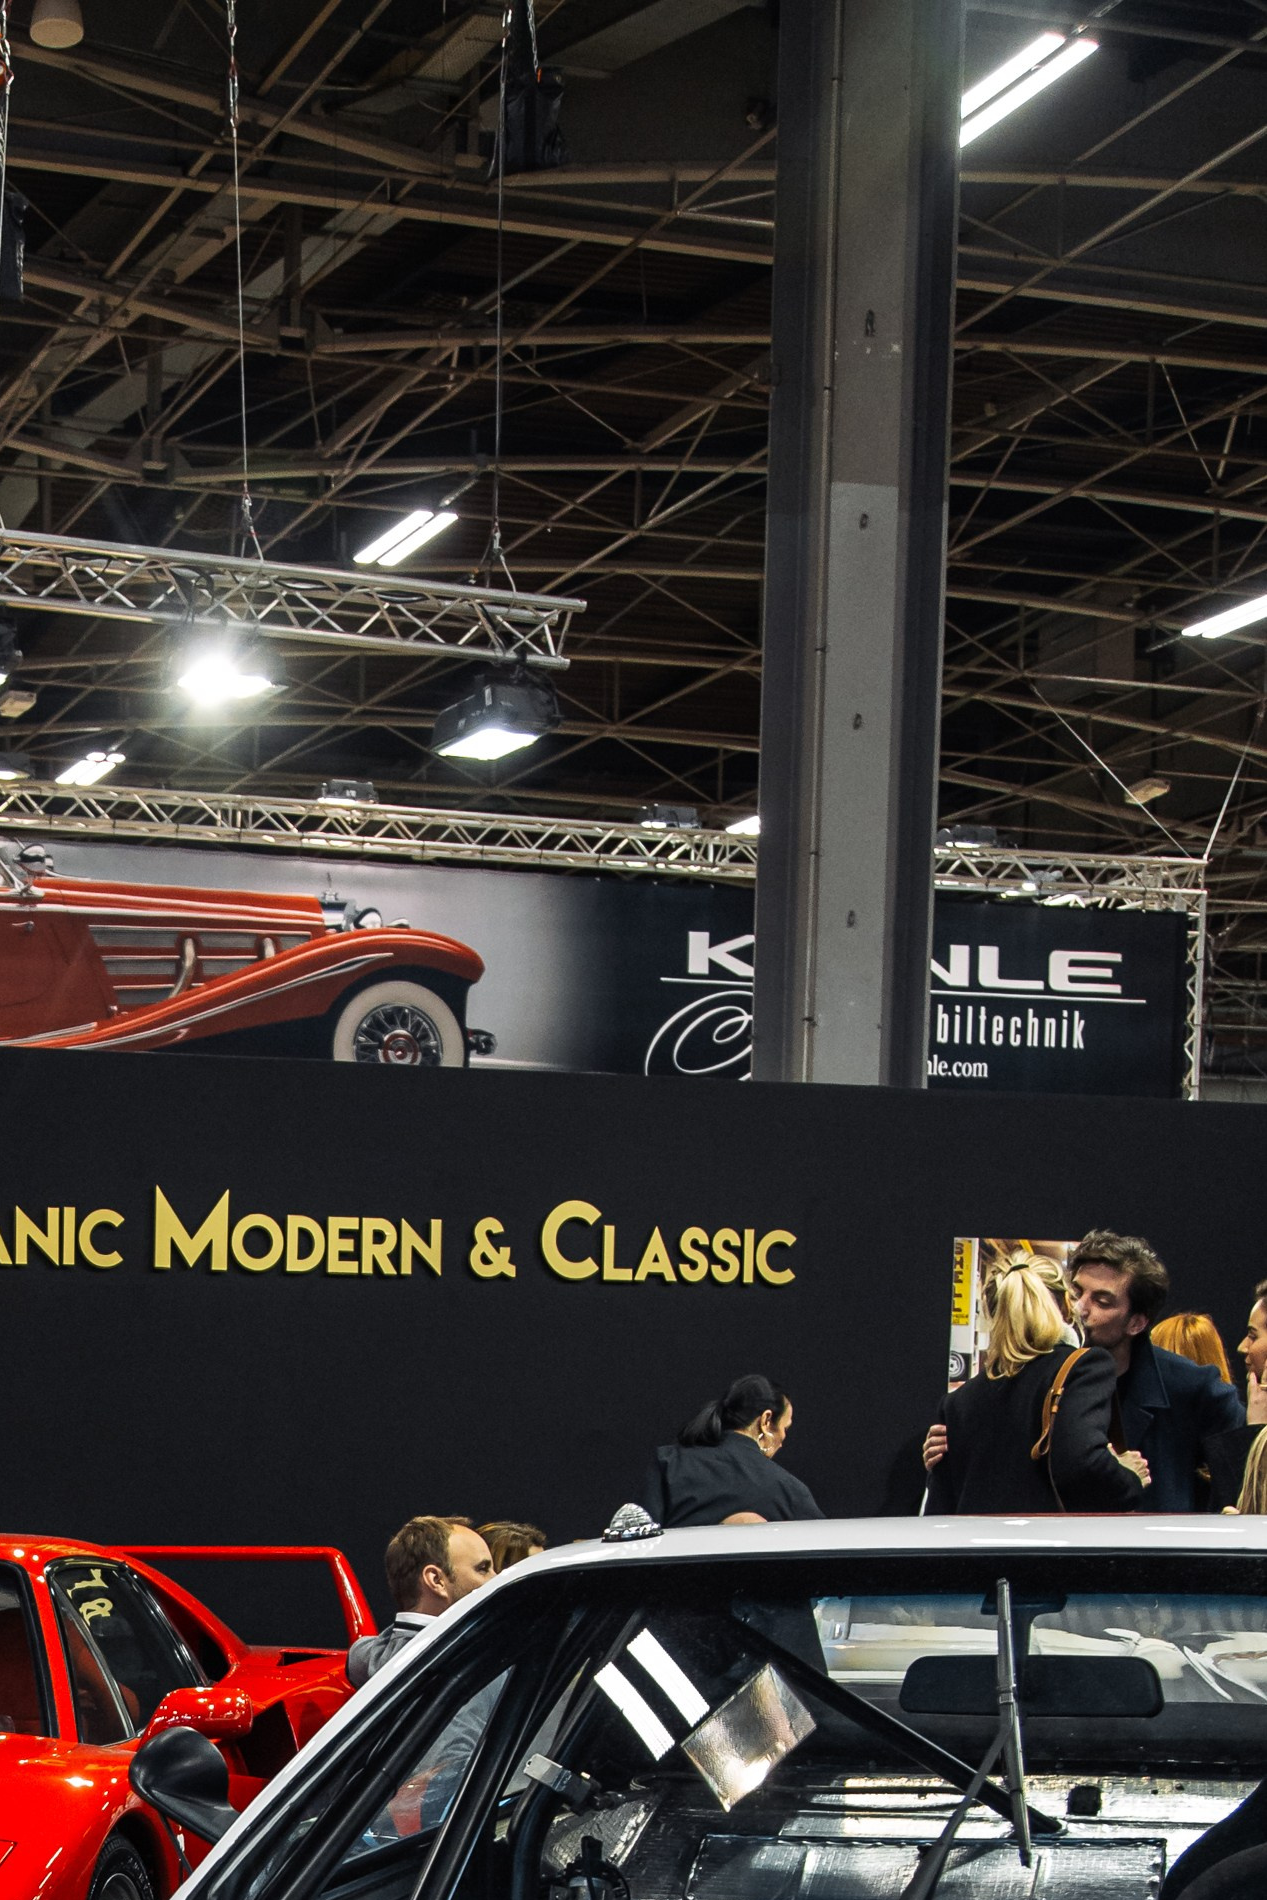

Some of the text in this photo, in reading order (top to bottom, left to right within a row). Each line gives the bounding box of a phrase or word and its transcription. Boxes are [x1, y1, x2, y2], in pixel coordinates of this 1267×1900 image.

[154, 1184, 443, 1277] MODERN
[469, 1216, 517, 1279] &
[540, 1199, 798, 1286] CLASSIC
